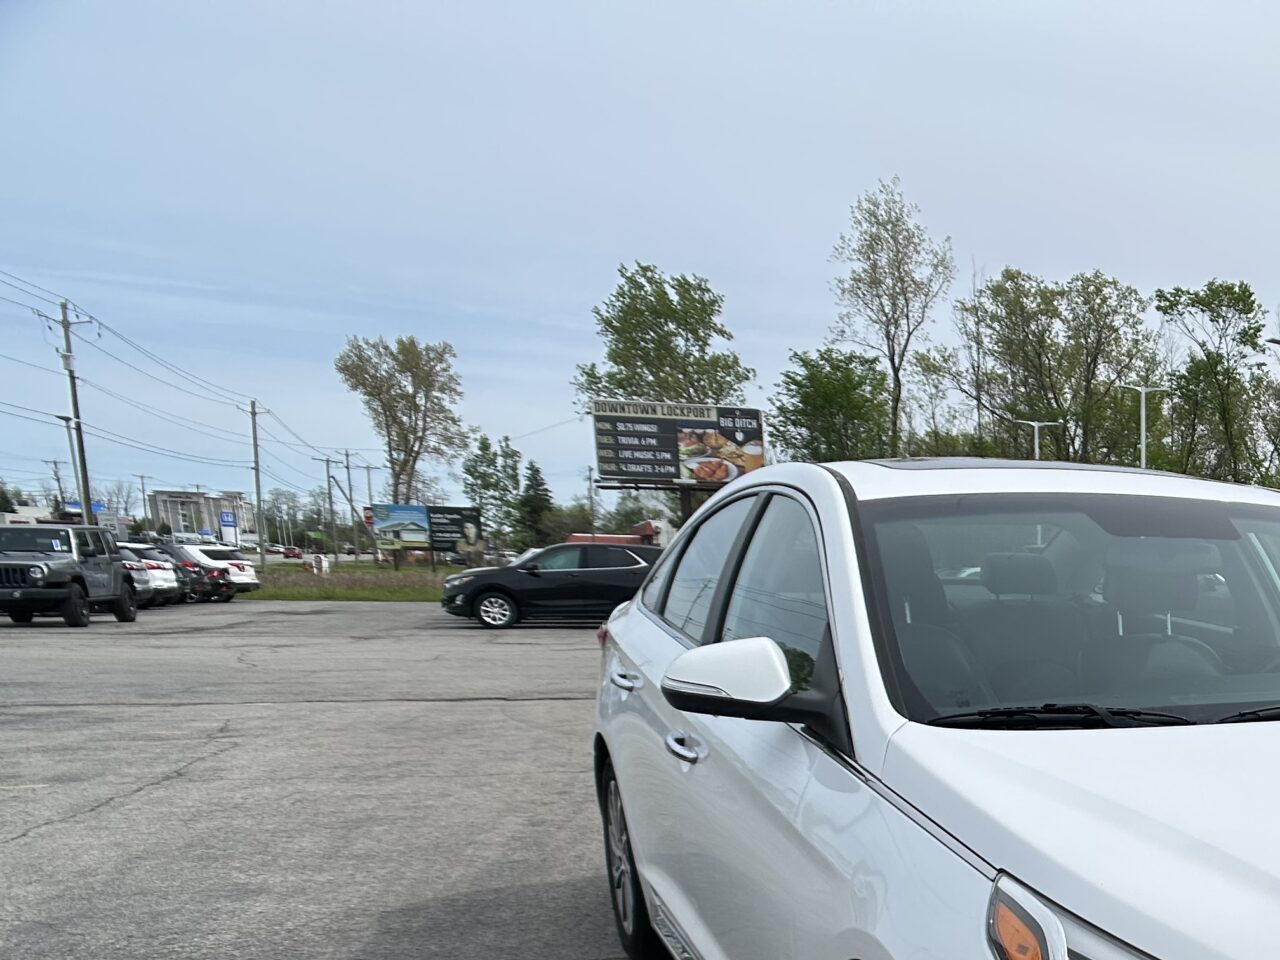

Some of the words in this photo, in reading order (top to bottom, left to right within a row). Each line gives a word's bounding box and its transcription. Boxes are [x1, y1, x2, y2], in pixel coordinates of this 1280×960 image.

[593, 401, 657, 415] DOWNTOWN
[661, 404, 712, 418] LOCKPORT
[719, 416, 733, 427] BIG
[735, 418, 757, 428] DITCH
[646, 437, 657, 446] PM
[618, 450, 633, 459] LIVE
[660, 452, 672, 460] PM
[664, 465, 677, 474] PM
